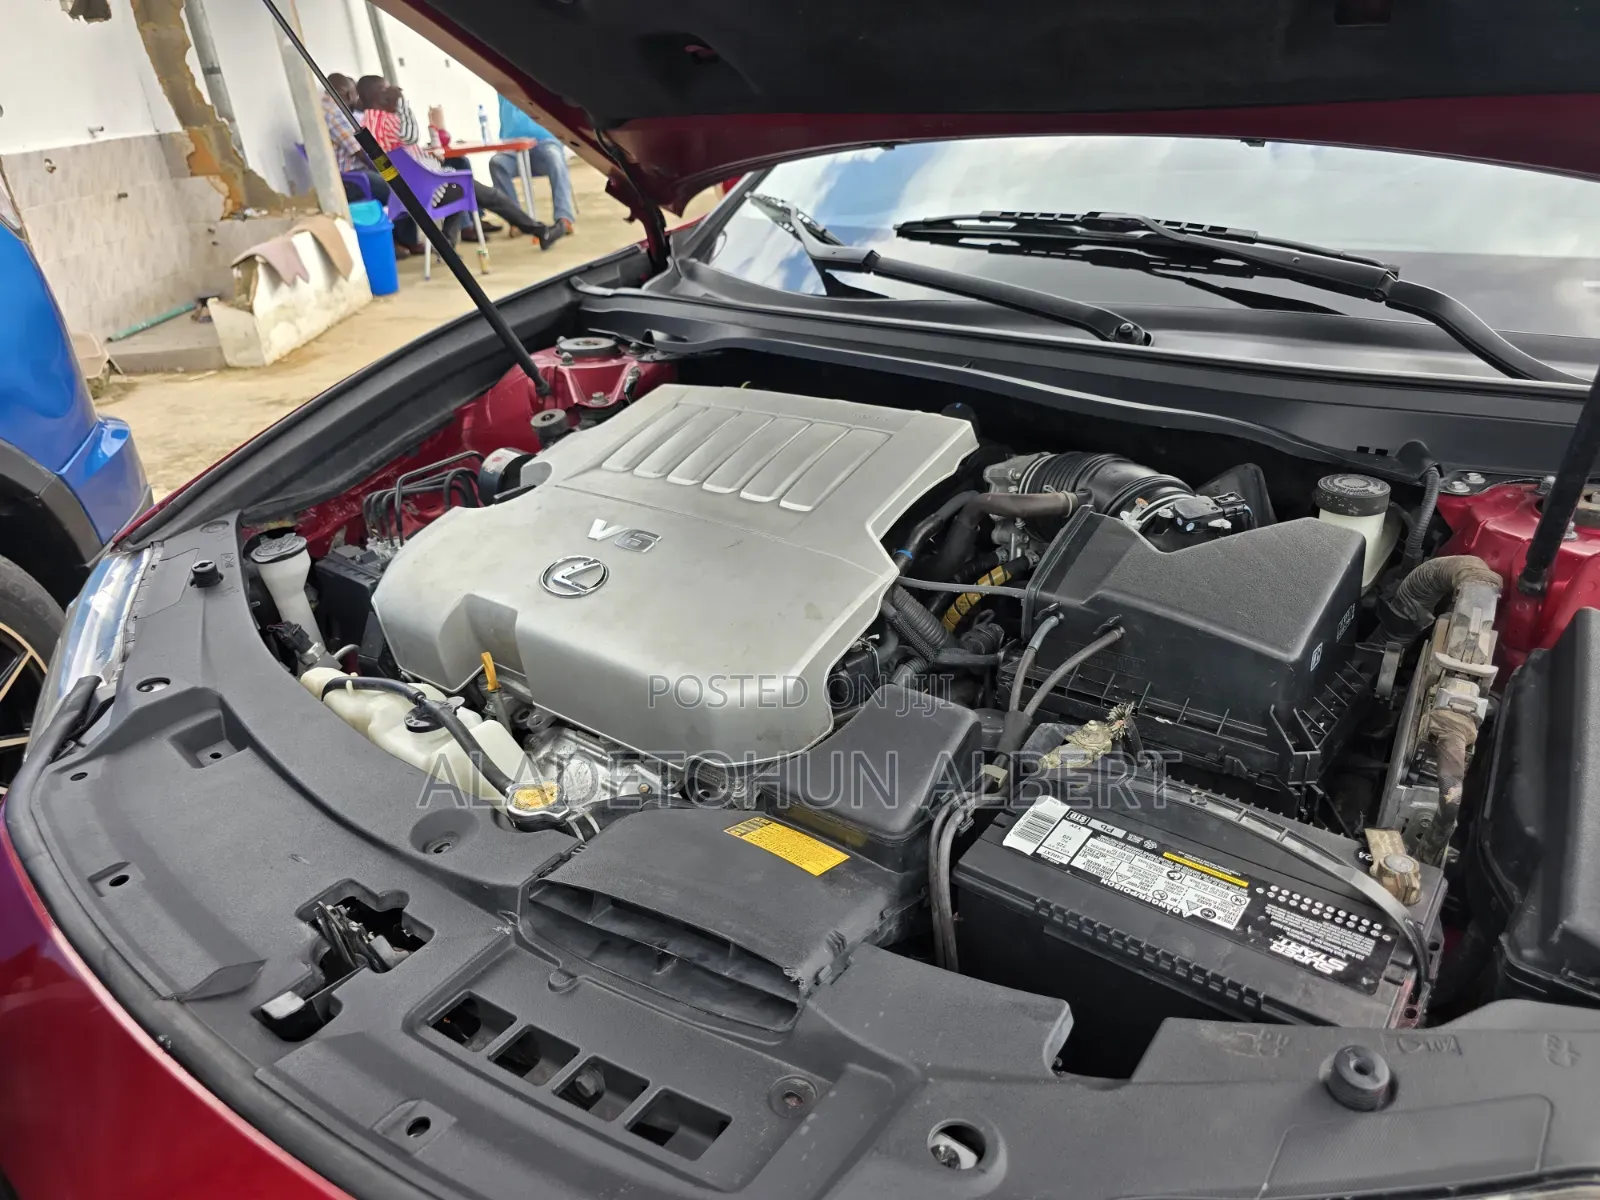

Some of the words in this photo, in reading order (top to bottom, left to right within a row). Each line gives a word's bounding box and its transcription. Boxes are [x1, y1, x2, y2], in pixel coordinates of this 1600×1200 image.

[587, 518, 663, 553] V6
[1098, 823, 1114, 833] Pb
[1100, 878, 1180, 914] DANGER/POISON
[1269, 942, 1333, 975] SUPER
[1273, 936, 1348, 972] START
